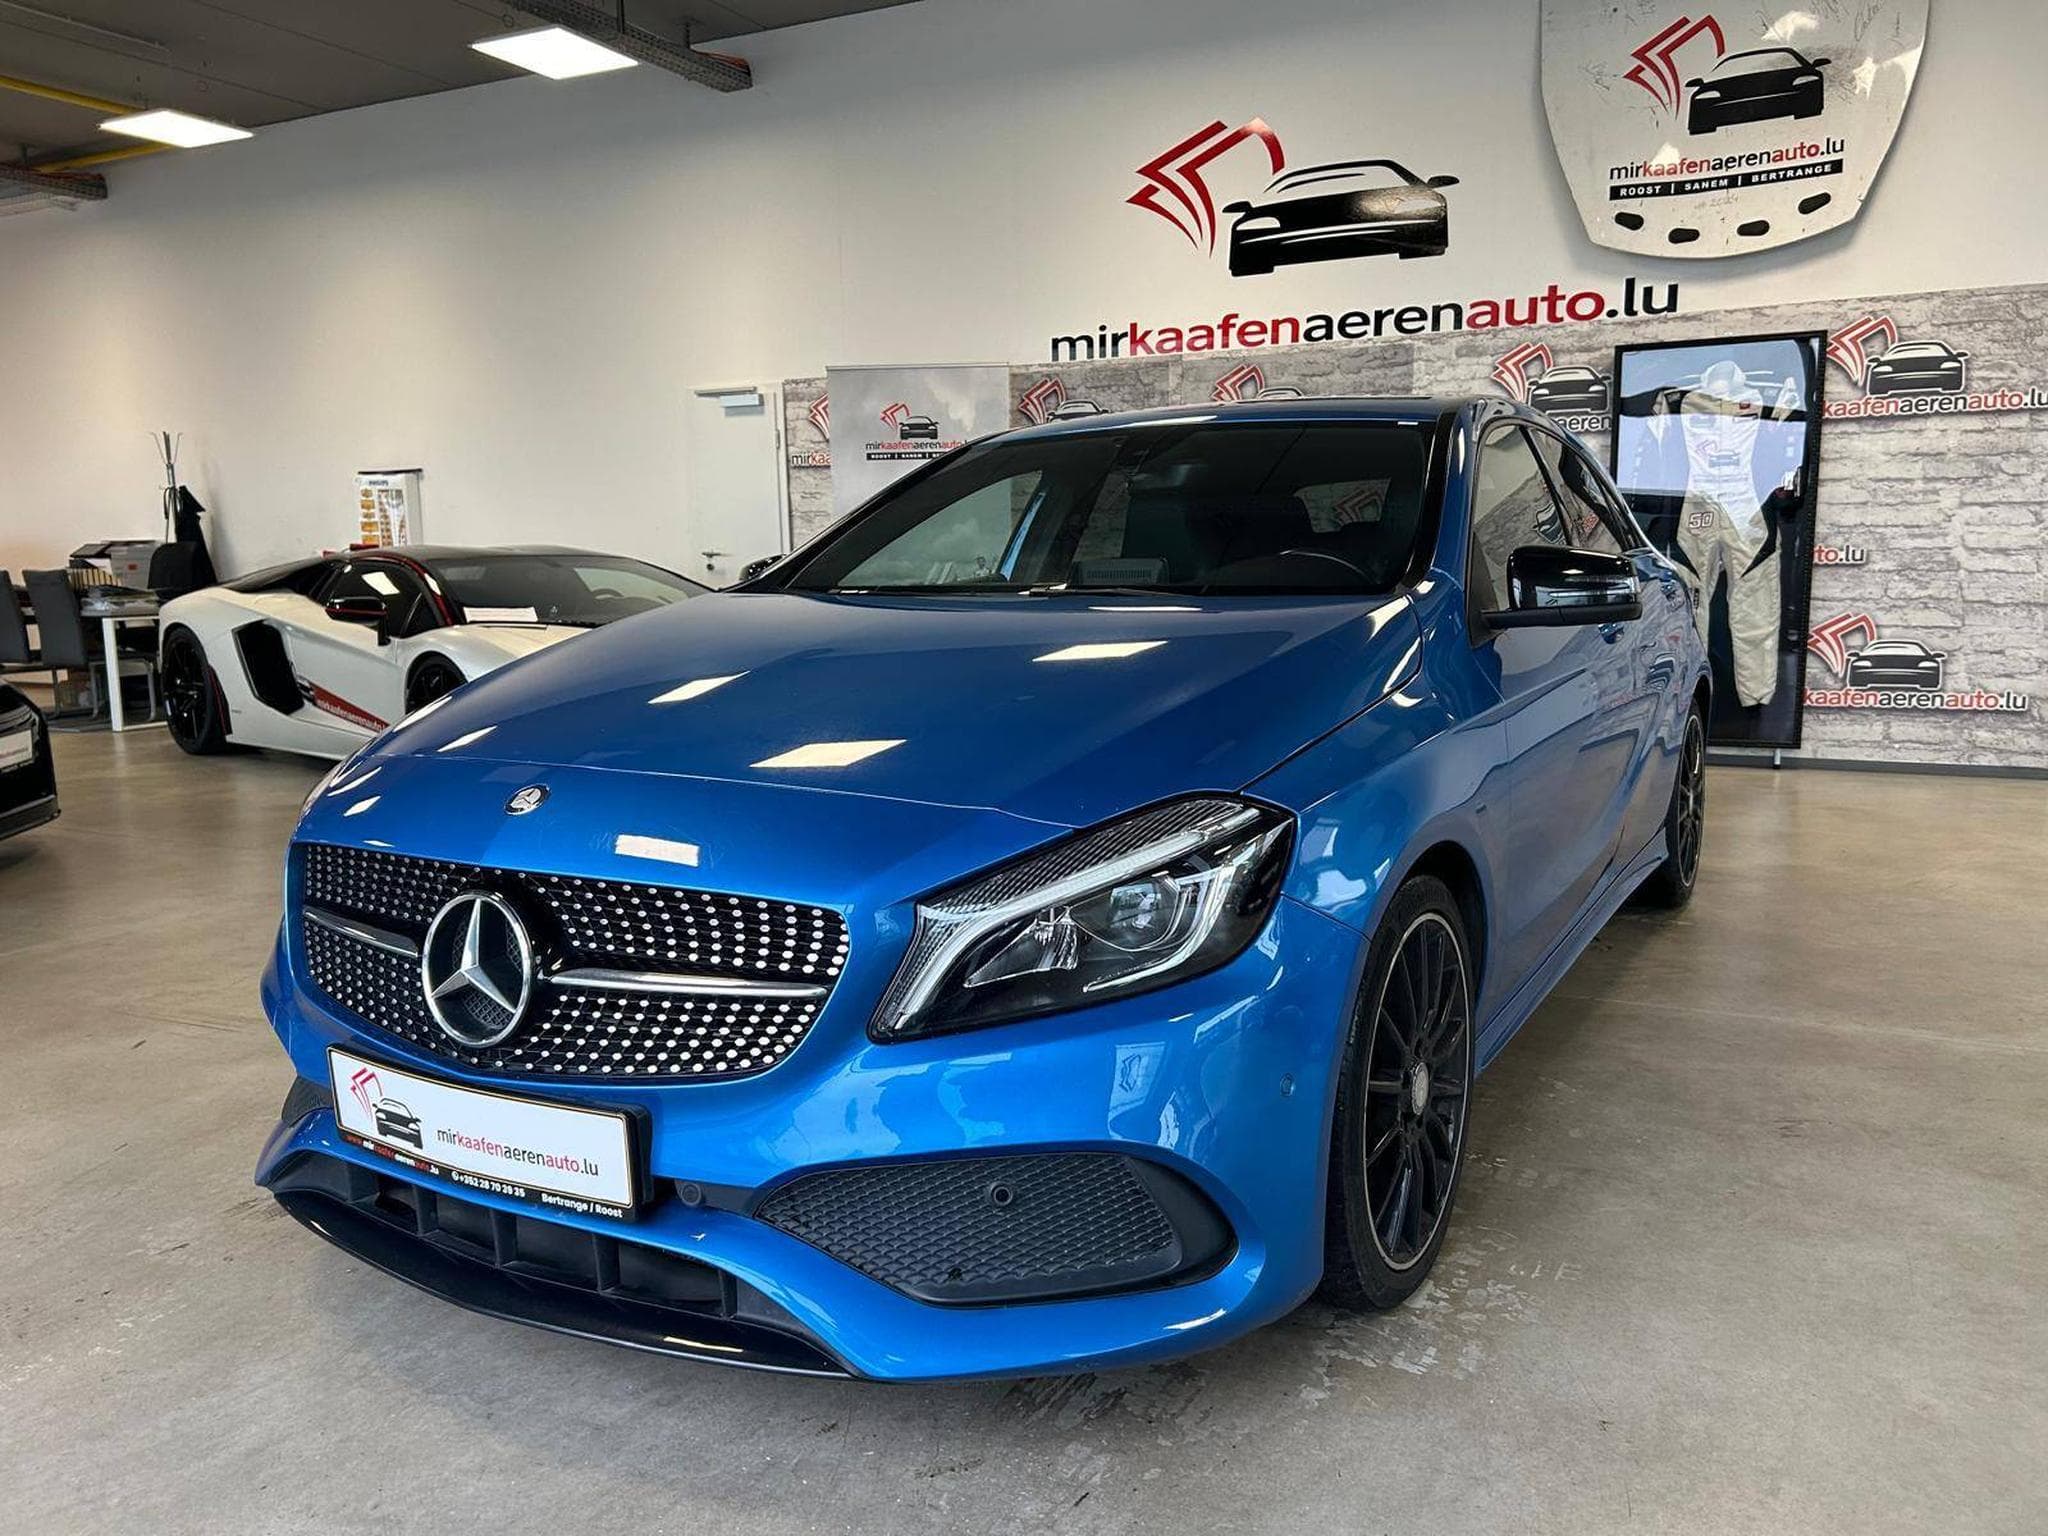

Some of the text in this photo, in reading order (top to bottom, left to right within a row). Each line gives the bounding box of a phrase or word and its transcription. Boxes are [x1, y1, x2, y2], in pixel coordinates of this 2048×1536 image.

[1609, 137, 1845, 180] mirkaafenaerenauto.lu
[1619, 186, 1662, 197] ROOST
[1684, 178, 1728, 191] SANEM
[1751, 164, 1833, 182] BERTRANGE
[1052, 278, 1679, 362] mirkaafenaerenauto.lu
[1822, 387, 2048, 418] kaafenaerenauto.lu
[1688, 511, 1715, 528] 50
[1803, 689, 2027, 710] kaafenaerenauto.lu
[436, 1127, 599, 1177] mirkaafenaerenauto.lu
[541, 1193, 589, 1213] Bertrange
[595, 1204, 624, 1219] Roost
